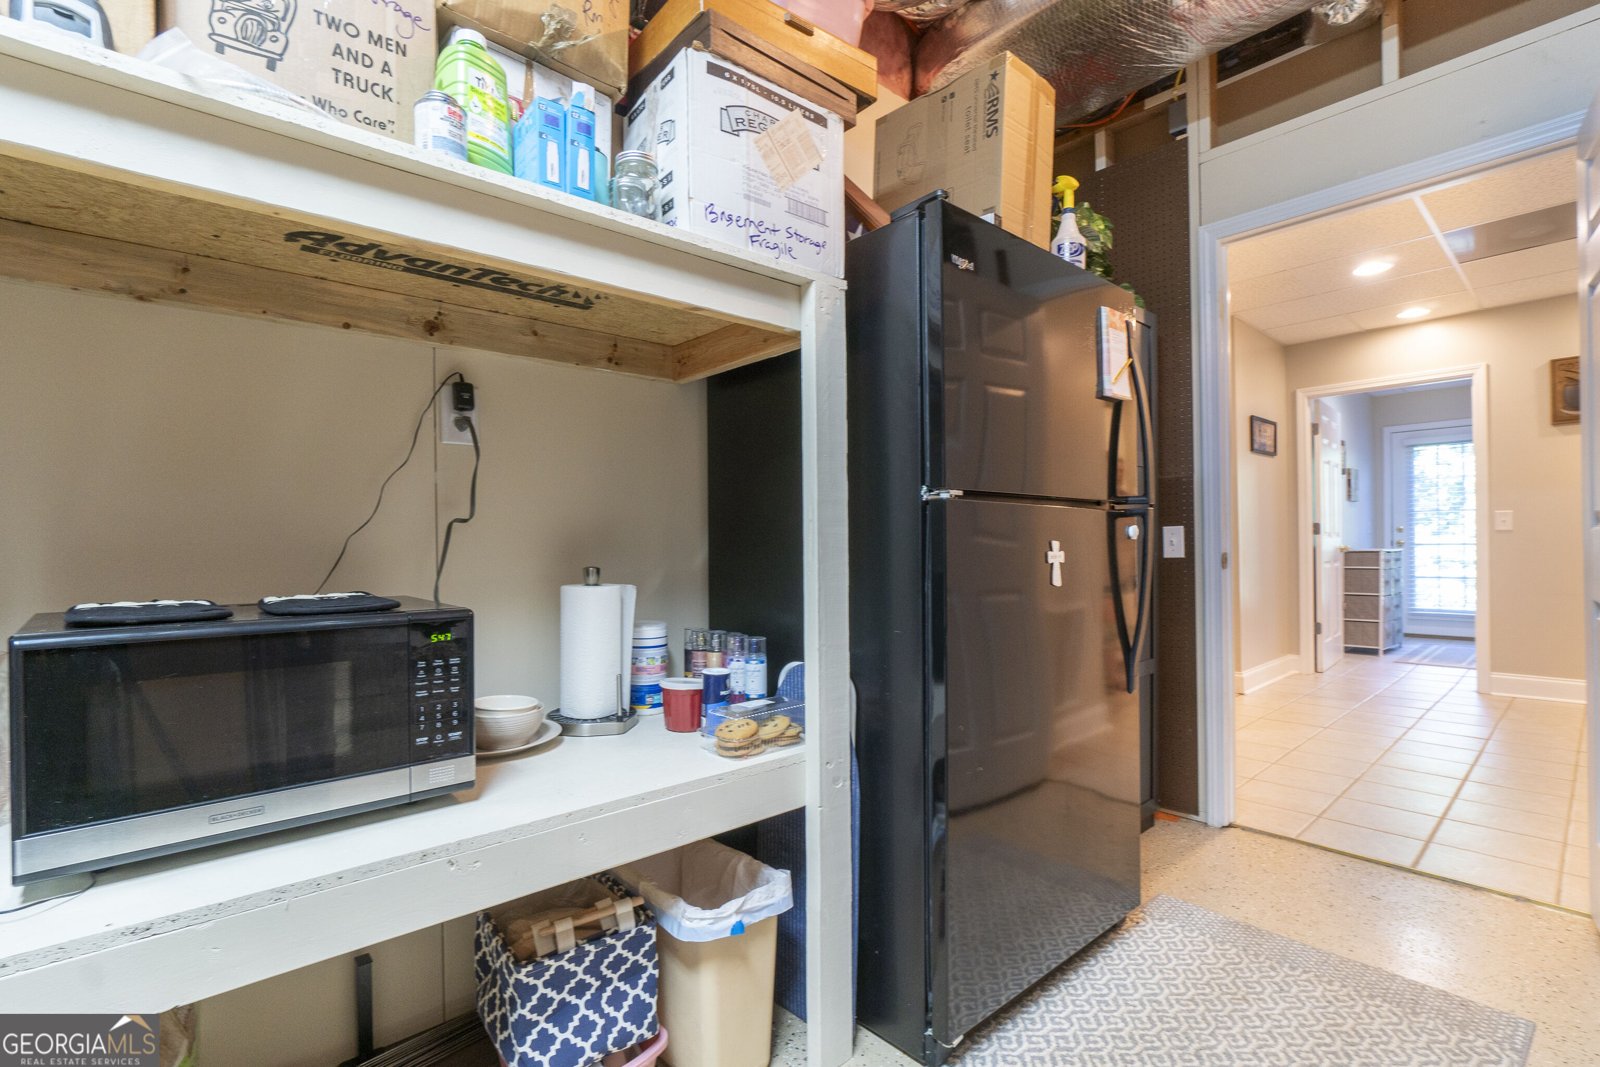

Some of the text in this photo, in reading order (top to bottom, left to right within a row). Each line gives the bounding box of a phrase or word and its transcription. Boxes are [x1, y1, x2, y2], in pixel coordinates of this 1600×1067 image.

[313, 9, 407, 57] TWO MEN
[331, 43, 393, 77] AND A
[704, 203, 781, 237] Basement
[785, 226, 828, 256] Storage
[749, 234, 798, 260] Fragile
